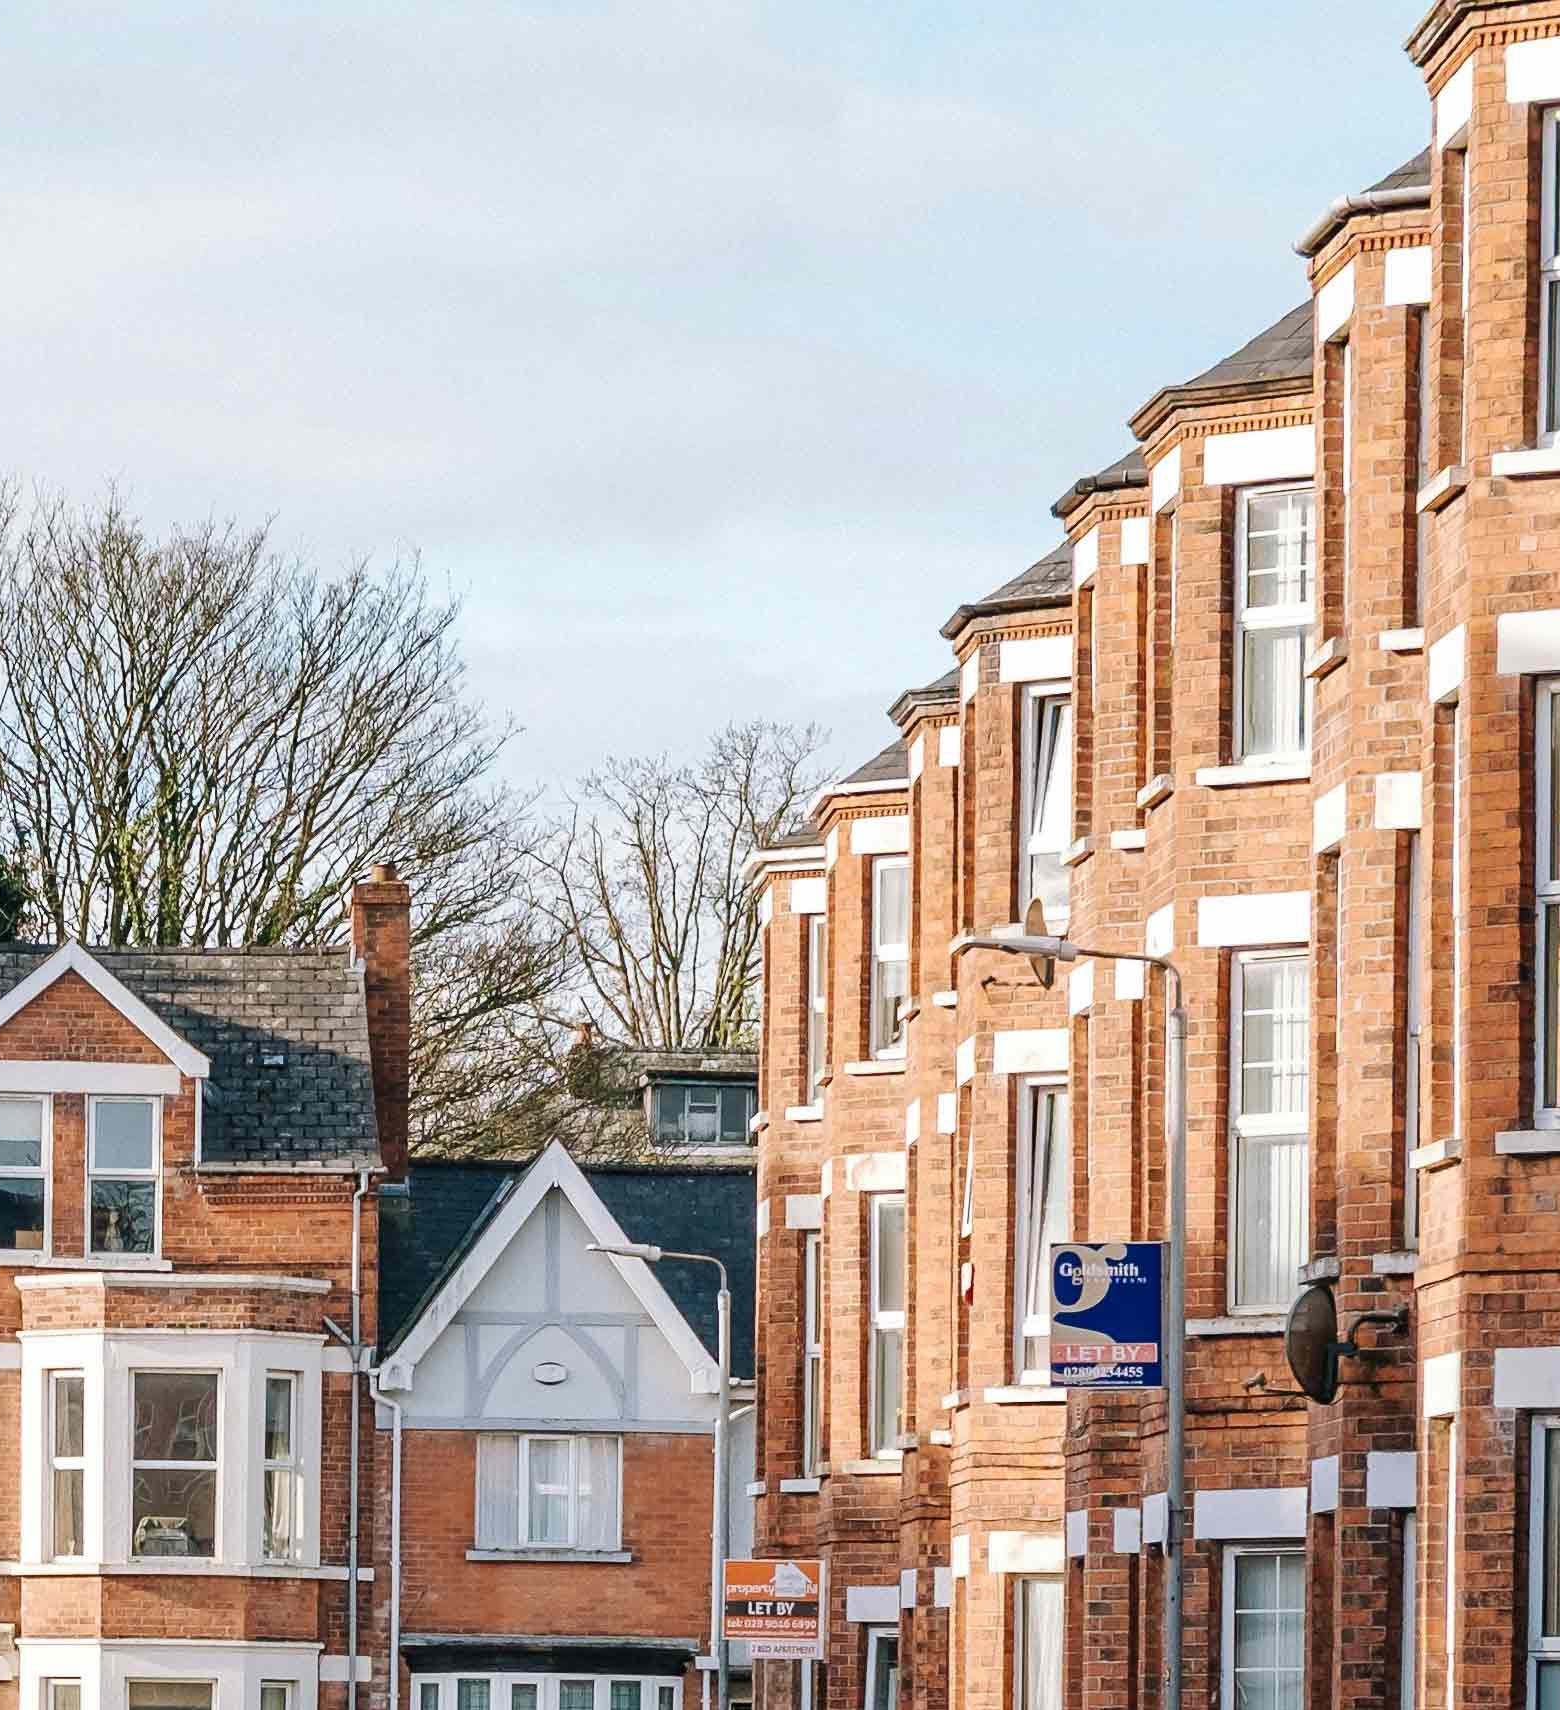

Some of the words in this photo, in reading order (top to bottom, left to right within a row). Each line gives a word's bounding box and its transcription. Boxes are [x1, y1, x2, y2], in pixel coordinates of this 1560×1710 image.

[1066, 1345, 1105, 1362] LET
[1112, 1345, 1141, 1362] BY
[747, 1601, 773, 1615] LET
[776, 1602, 795, 1615] BY
